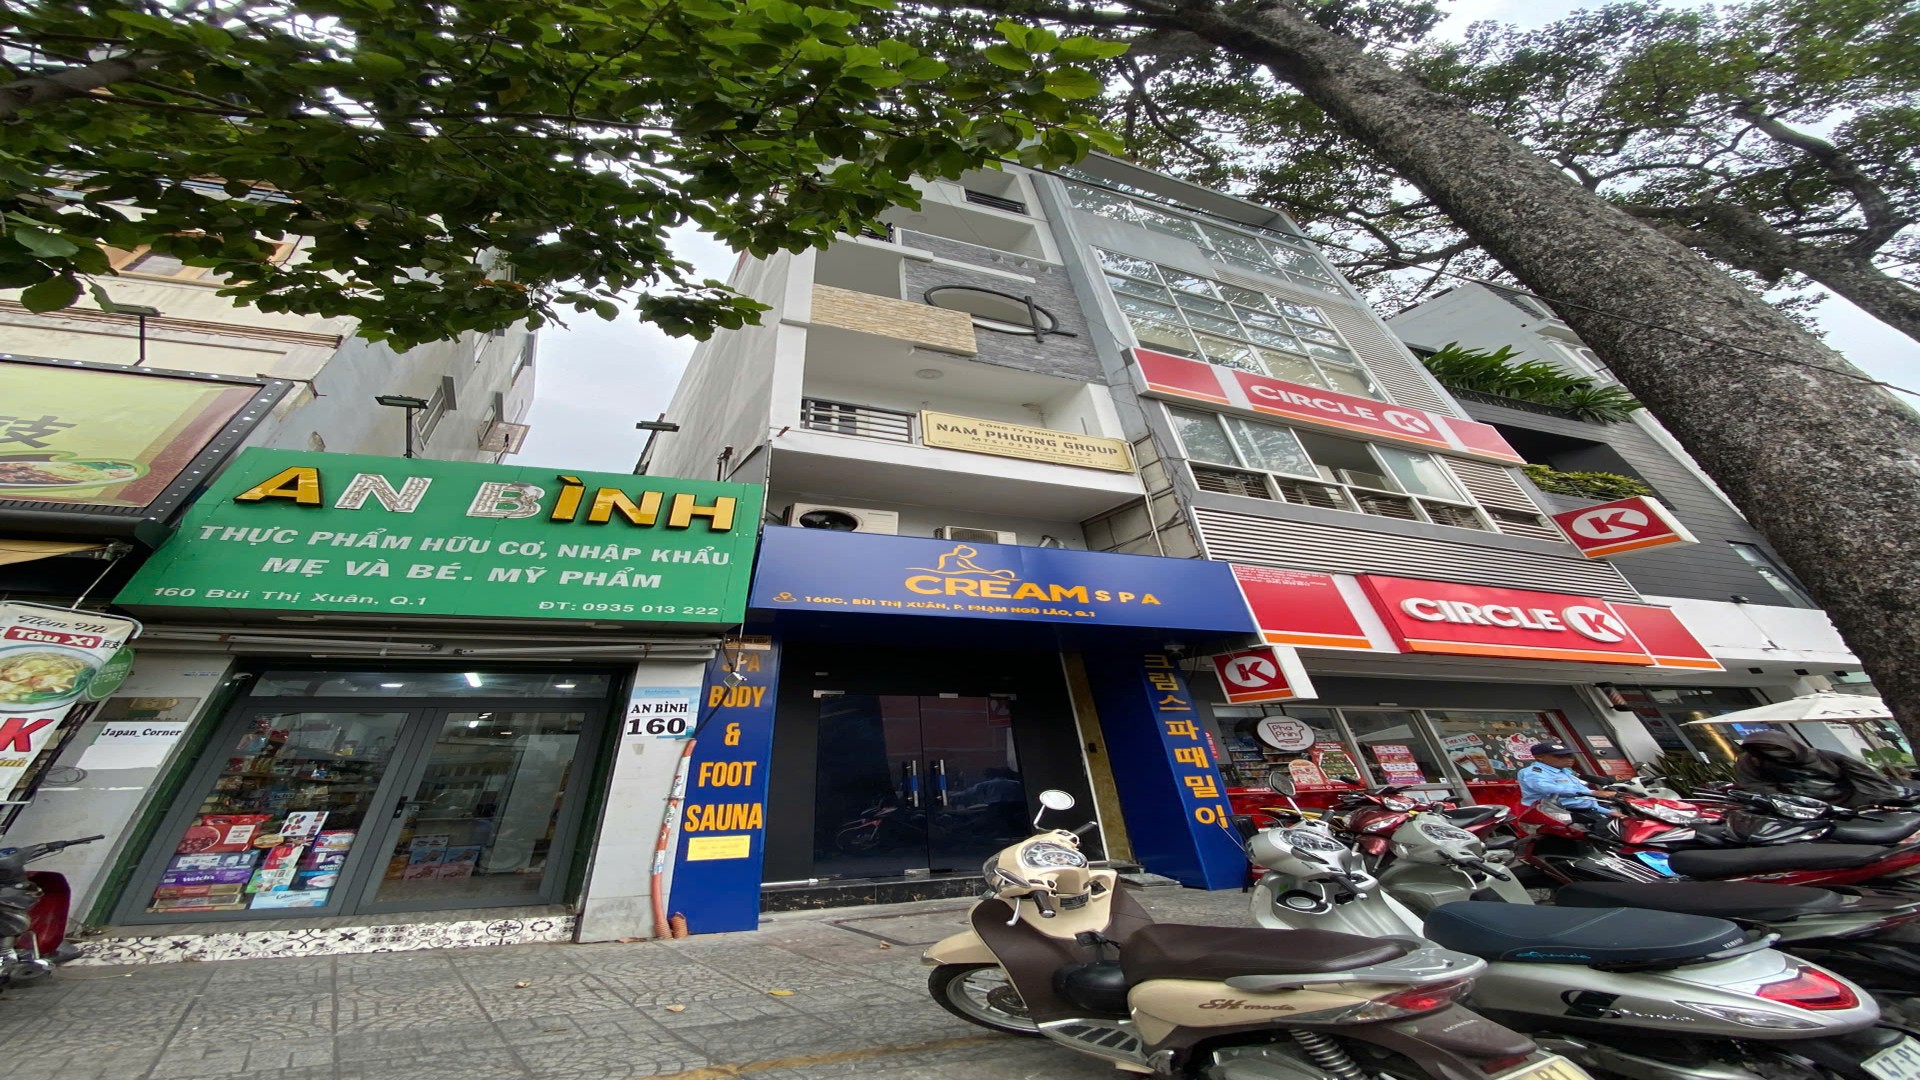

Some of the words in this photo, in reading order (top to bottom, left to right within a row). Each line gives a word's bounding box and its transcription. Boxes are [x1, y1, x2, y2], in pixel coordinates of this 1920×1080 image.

[1250, 385, 1378, 421] CIRCLE
[1386, 410, 1430, 434] K
[936, 423, 978, 436] NAM
[985, 430, 1057, 447] PHƯƠNG
[1063, 442, 1118, 455] GROUP
[233, 466, 434, 513] AN
[465, 475, 739, 532] BÌNH
[1580, 508, 1647, 537] K
[199, 525, 299, 546] THỰC
[307, 528, 413, 550] PHẨM
[419, 536, 491, 554] HỮU
[498, 541, 548, 559] CƠ,
[557, 543, 641, 563] NHẬP
[651, 546, 730, 566] KHẨU
[260, 557, 330, 578] MẸ
[345, 559, 390, 577] VÀ
[487, 566, 547, 584] MỸ
[558, 567, 662, 589] PHẨM
[153, 588, 196, 597] 160
[204, 589, 251, 599] Bùi
[261, 591, 301, 603] Thị
[310, 593, 379, 605] Xuân,
[389, 596, 427, 606] Q.1
[904, 574, 1089, 604] CREAM
[538, 601, 577, 611] ĐT:
[582, 602, 634, 612] 0935
[641, 604, 676, 614] 013
[682, 606, 719, 615] 222
[805, 596, 848, 605] 160C,
[852, 597, 876, 606] BÙI
[880, 600, 901, 609] THỊ
[906, 602, 950, 611] XUÂN,
[968, 605, 1007, 614] PHẠM
[1011, 607, 1040, 615] NGŨ
[1043, 608, 1072, 617] LÃO,
[1400, 596, 1565, 632] CIRCLE
[1576, 608, 1626, 642] K
[14, 628, 61, 642] Tàu
[64, 635, 96, 646] Xì
[1230, 658, 1275, 686] K
[630, 703, 652, 714] AN
[708, 686, 767, 708] BODY
[627, 718, 686, 736] 160
[724, 722, 741, 746] &
[698, 761, 757, 787] FOOT
[684, 803, 763, 832] SAUNA
